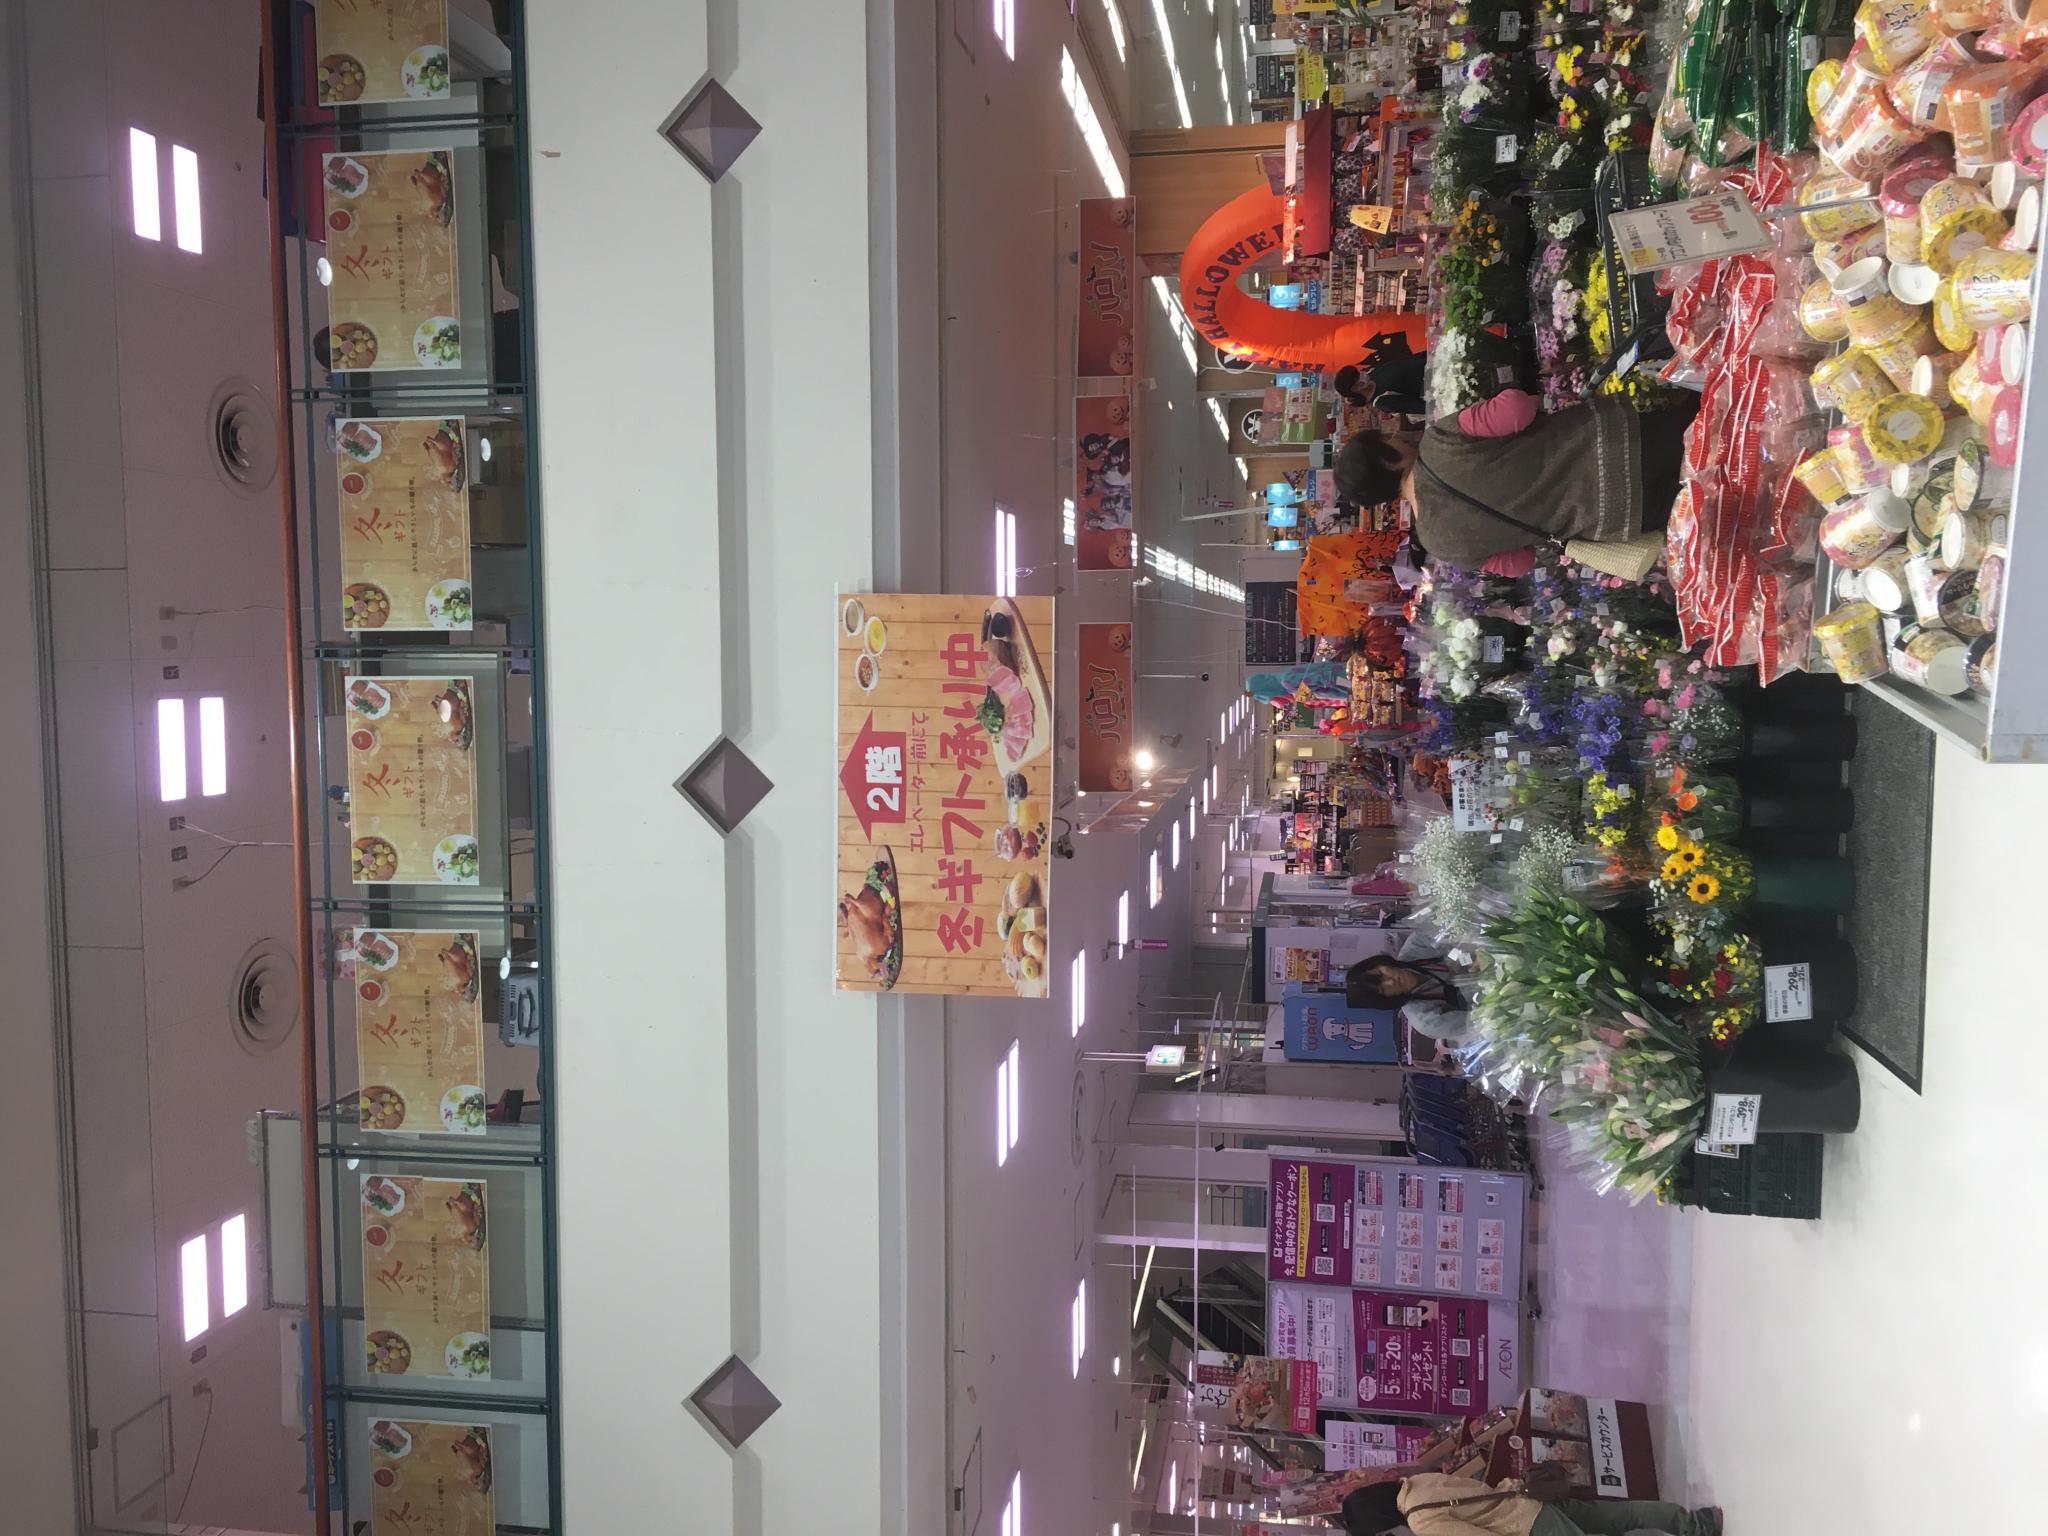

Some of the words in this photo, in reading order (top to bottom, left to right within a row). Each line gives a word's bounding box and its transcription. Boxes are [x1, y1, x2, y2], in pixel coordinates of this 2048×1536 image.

[341, 245, 380, 281] 冬
[380, 245, 394, 280] ギフト
[1193, 223, 1284, 340] HALLOWE
[1272, 289, 1288, 301] 3
[1279, 376, 1292, 385] 5
[353, 507, 393, 544] 冬
[393, 509, 407, 543] ギフト
[362, 764, 401, 799] 冬
[402, 766, 415, 799] ギフト
[864, 745, 903, 811] 2階
[910, 711, 929, 853] エレベーター前にて
[936, 632, 989, 954] 冬ギフト承り中
[370, 1014, 409, 1048] 冬
[410, 1015, 423, 1048] ギフト
[1274, 1181, 1284, 1247] イオンお買物アプリ
[1284, 1164, 1297, 1276] 今、配信中のおトクなクーポン
[376, 1261, 414, 1295] 冬
[416, 1263, 428, 1295] ギフト
[1278, 1301, 1286, 1356] オンお買物アプリ
[1411, 1353, 1422, 1400] クーポンを
[1422, 1341, 1433, 1391] プレゼント!
[1596, 1407, 1615, 1474] サービスカウンター
